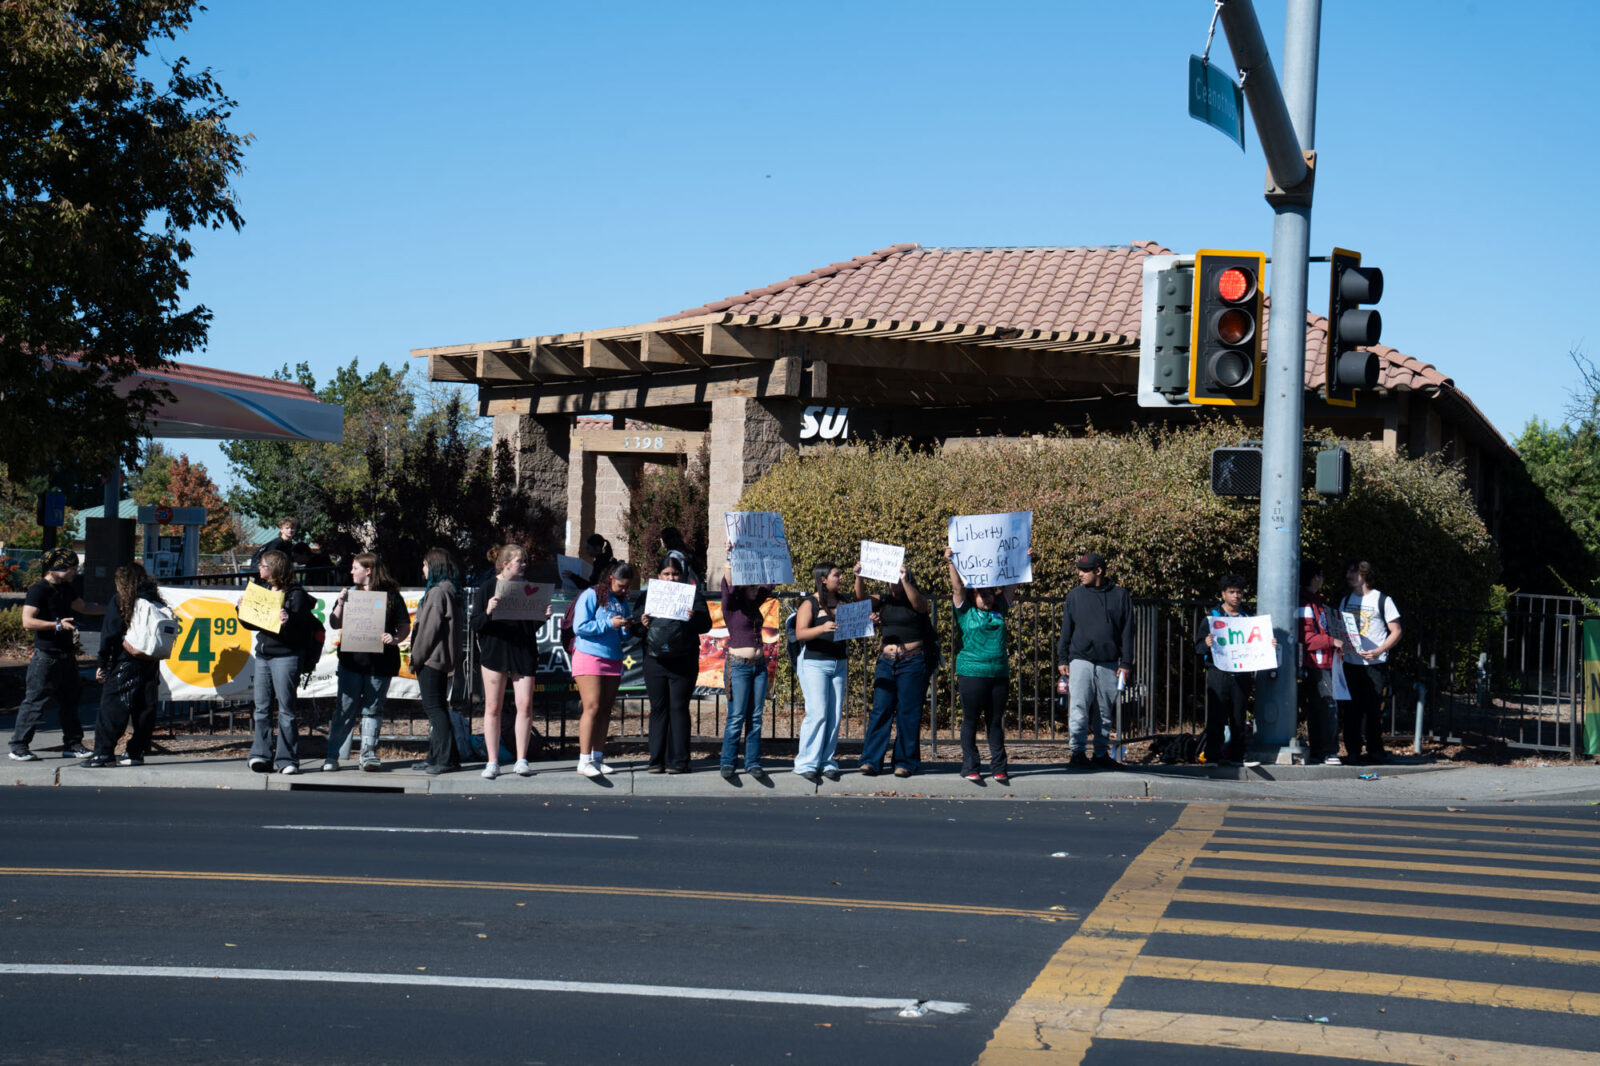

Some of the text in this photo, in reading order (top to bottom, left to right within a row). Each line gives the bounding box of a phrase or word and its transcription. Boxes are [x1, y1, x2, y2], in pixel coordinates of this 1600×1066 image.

[799, 406, 848, 438] SU
[624, 436, 664, 449] 1398
[956, 522, 1002, 542] Liberty
[997, 536, 1020, 552] AND
[996, 567, 1020, 582] ALL
